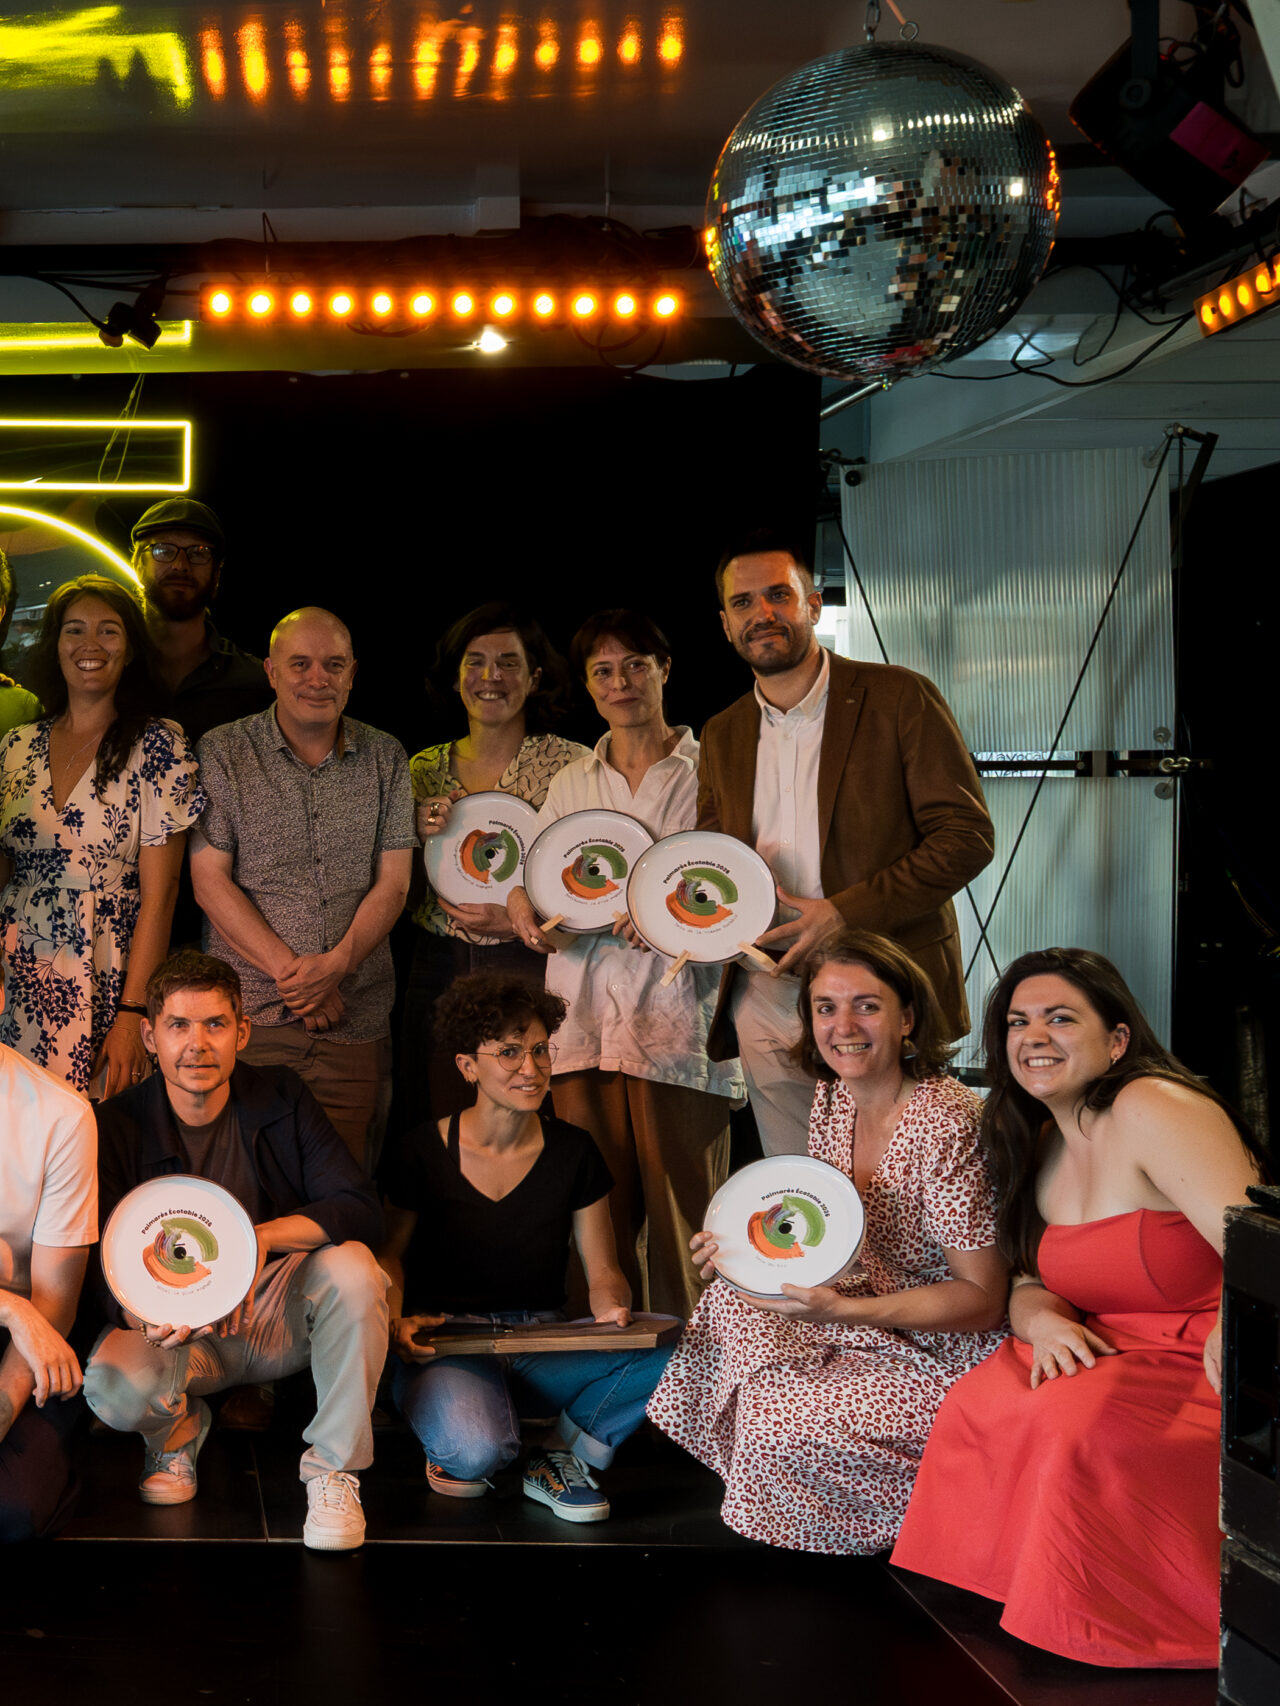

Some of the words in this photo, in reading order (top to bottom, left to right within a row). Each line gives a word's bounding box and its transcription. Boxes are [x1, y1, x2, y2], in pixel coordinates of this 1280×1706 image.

[663, 863, 687, 884] Palmarès
[716, 864, 730, 874] 2026
[761, 1188, 794, 1200] Palmarès
[796, 1188, 821, 1204] Écotable
[820, 1203, 831, 1217] 2026
[141, 1212, 168, 1234] Palmarès
[169, 1208, 197, 1217] Écotable
[198, 1214, 212, 1227] 2026
